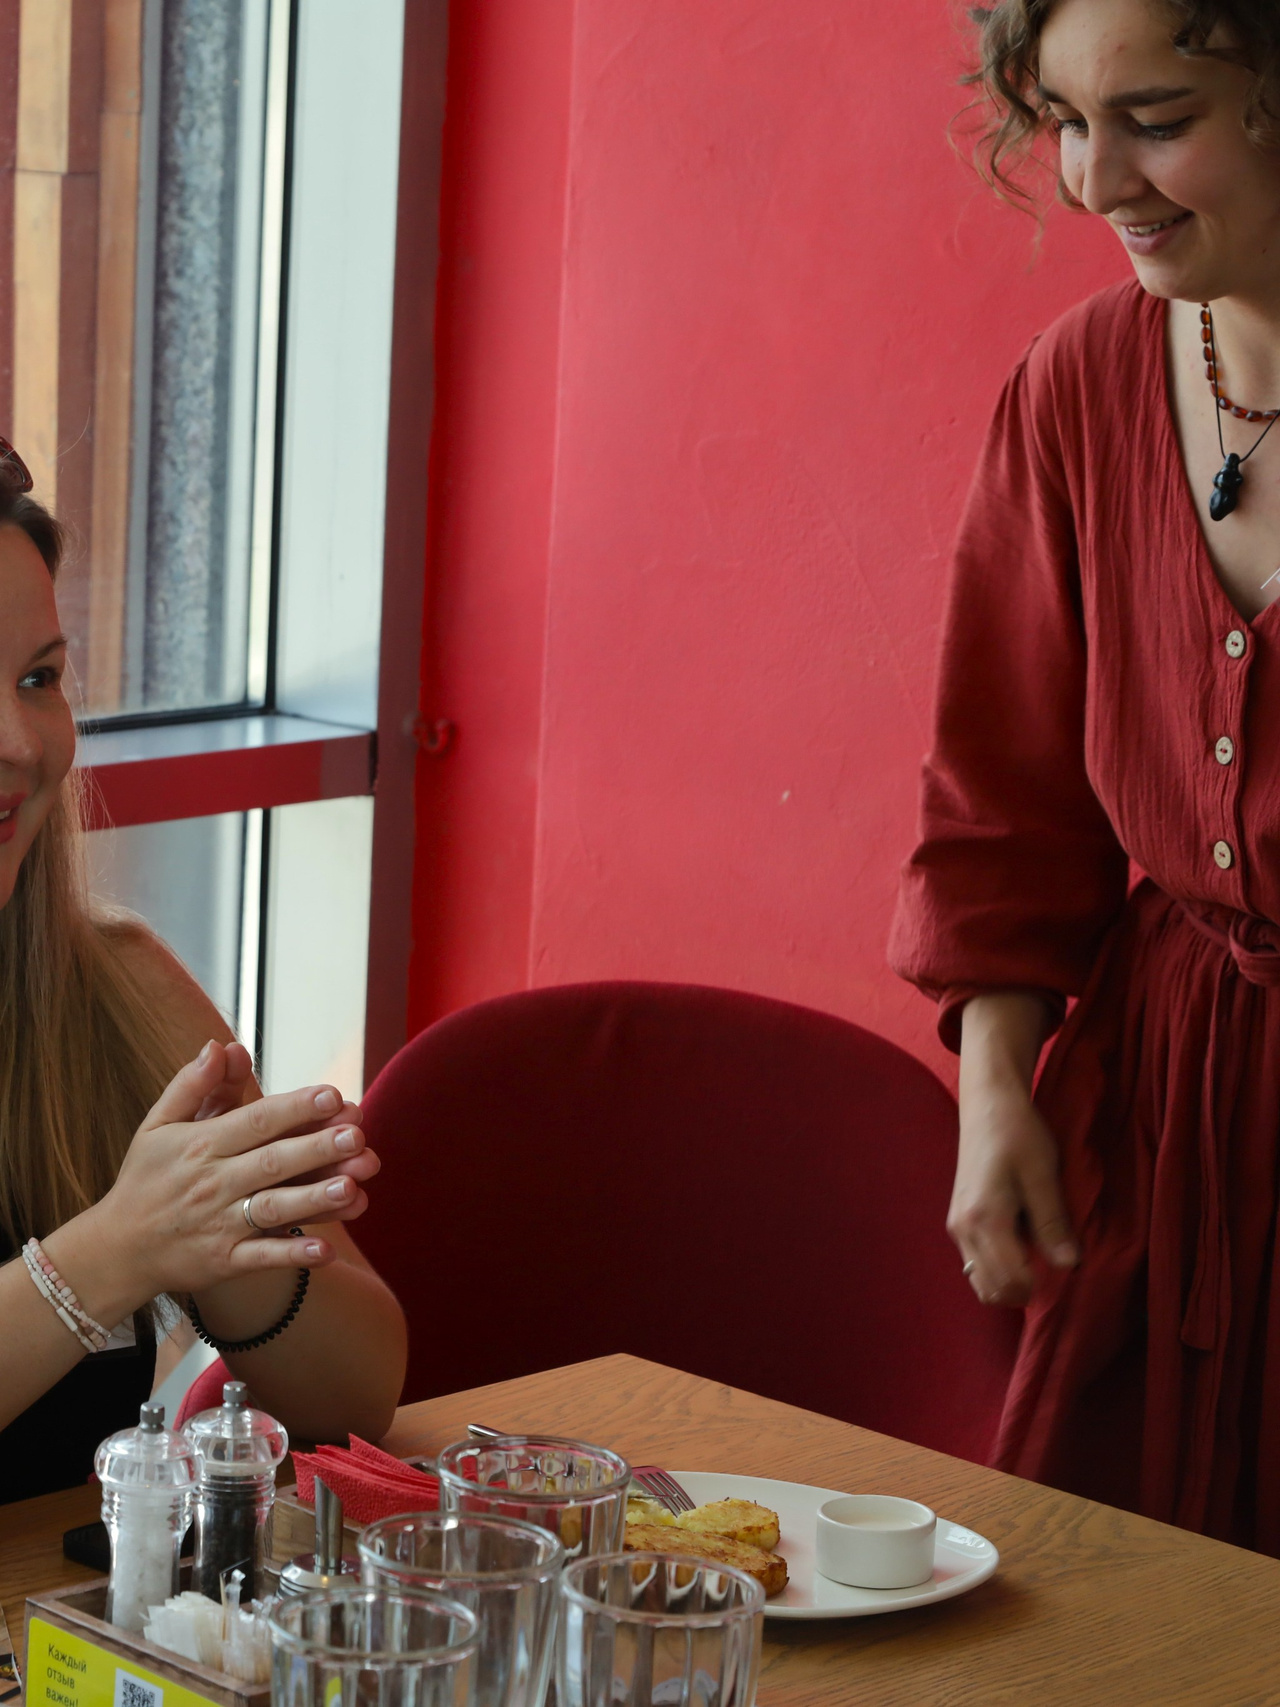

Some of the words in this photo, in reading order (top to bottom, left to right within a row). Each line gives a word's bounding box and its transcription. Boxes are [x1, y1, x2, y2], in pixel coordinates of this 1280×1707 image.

[48, 1643, 87, 1674] Каждый
[46, 1667, 75, 1690] отзыв
[45, 1687, 79, 1707] важен!
